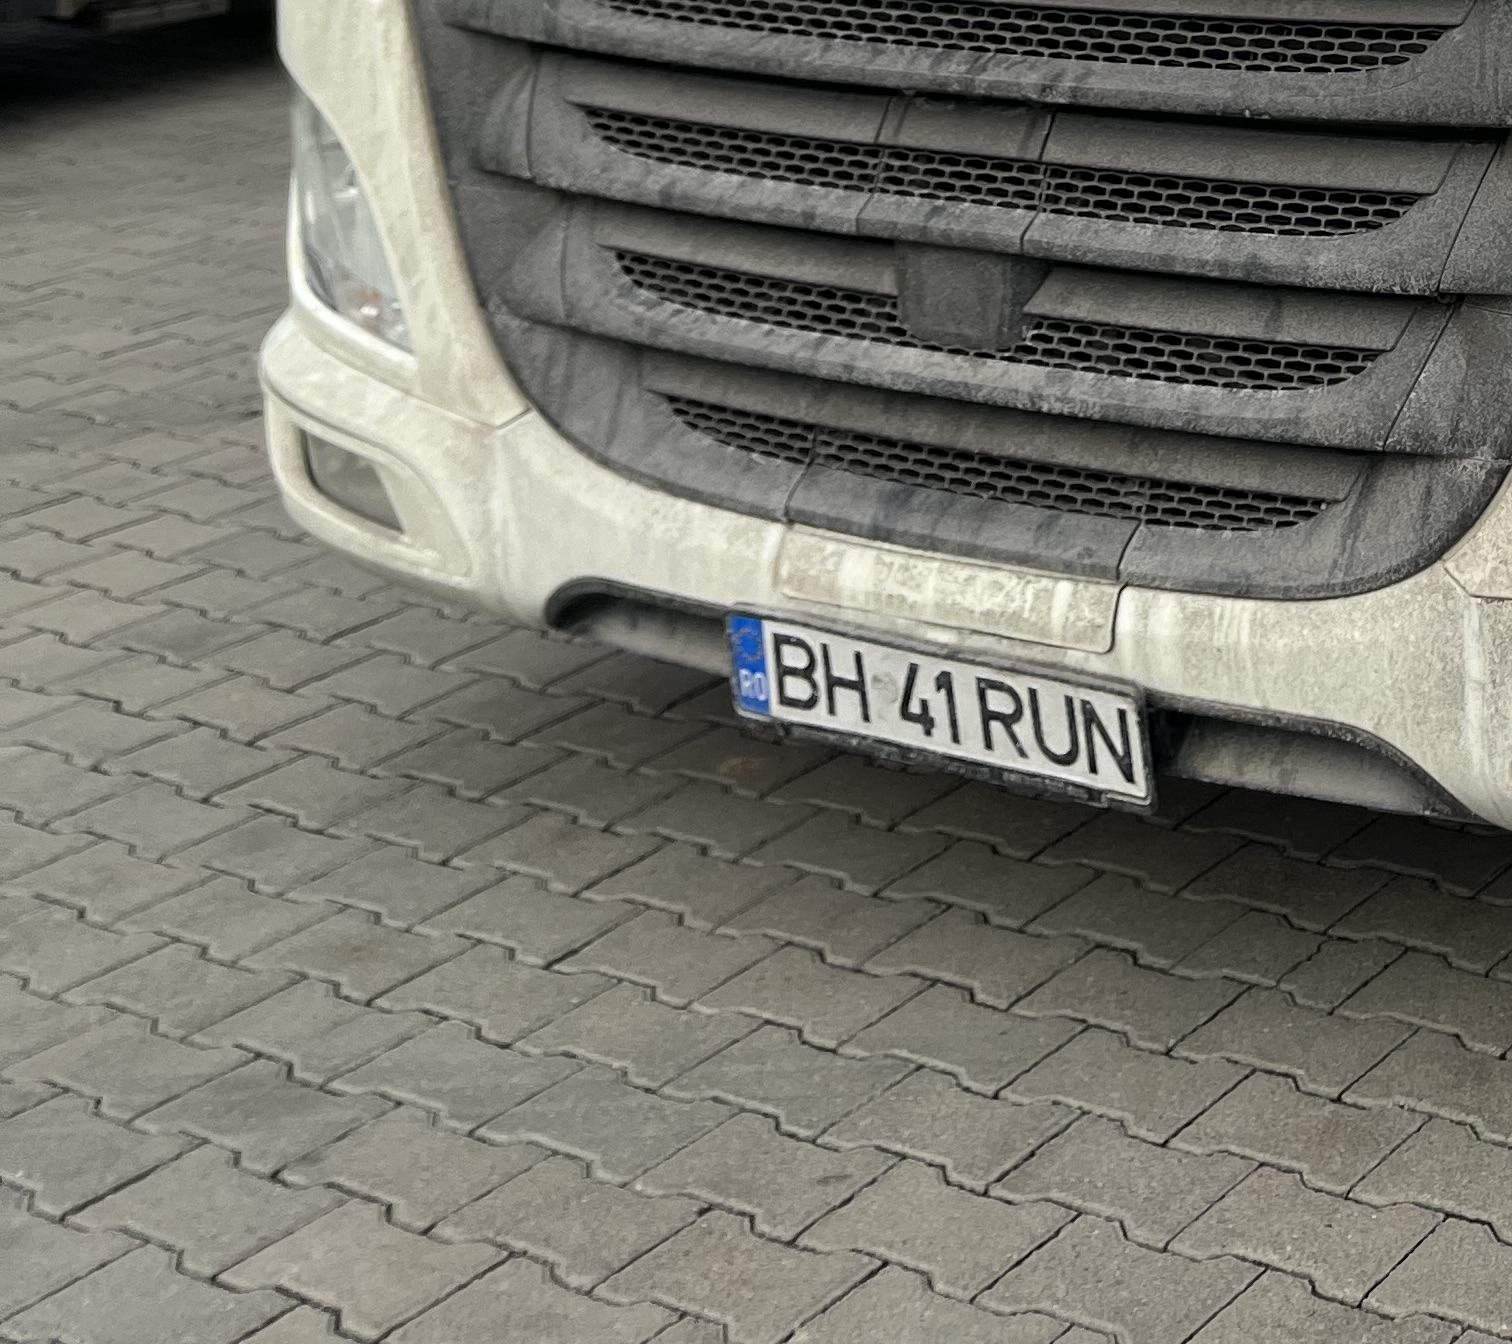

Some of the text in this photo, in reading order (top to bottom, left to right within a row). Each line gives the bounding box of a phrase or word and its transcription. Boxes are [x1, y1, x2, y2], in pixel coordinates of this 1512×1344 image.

[739, 668, 769, 701] RO
[772, 633, 1136, 785] BH 41 RUN
